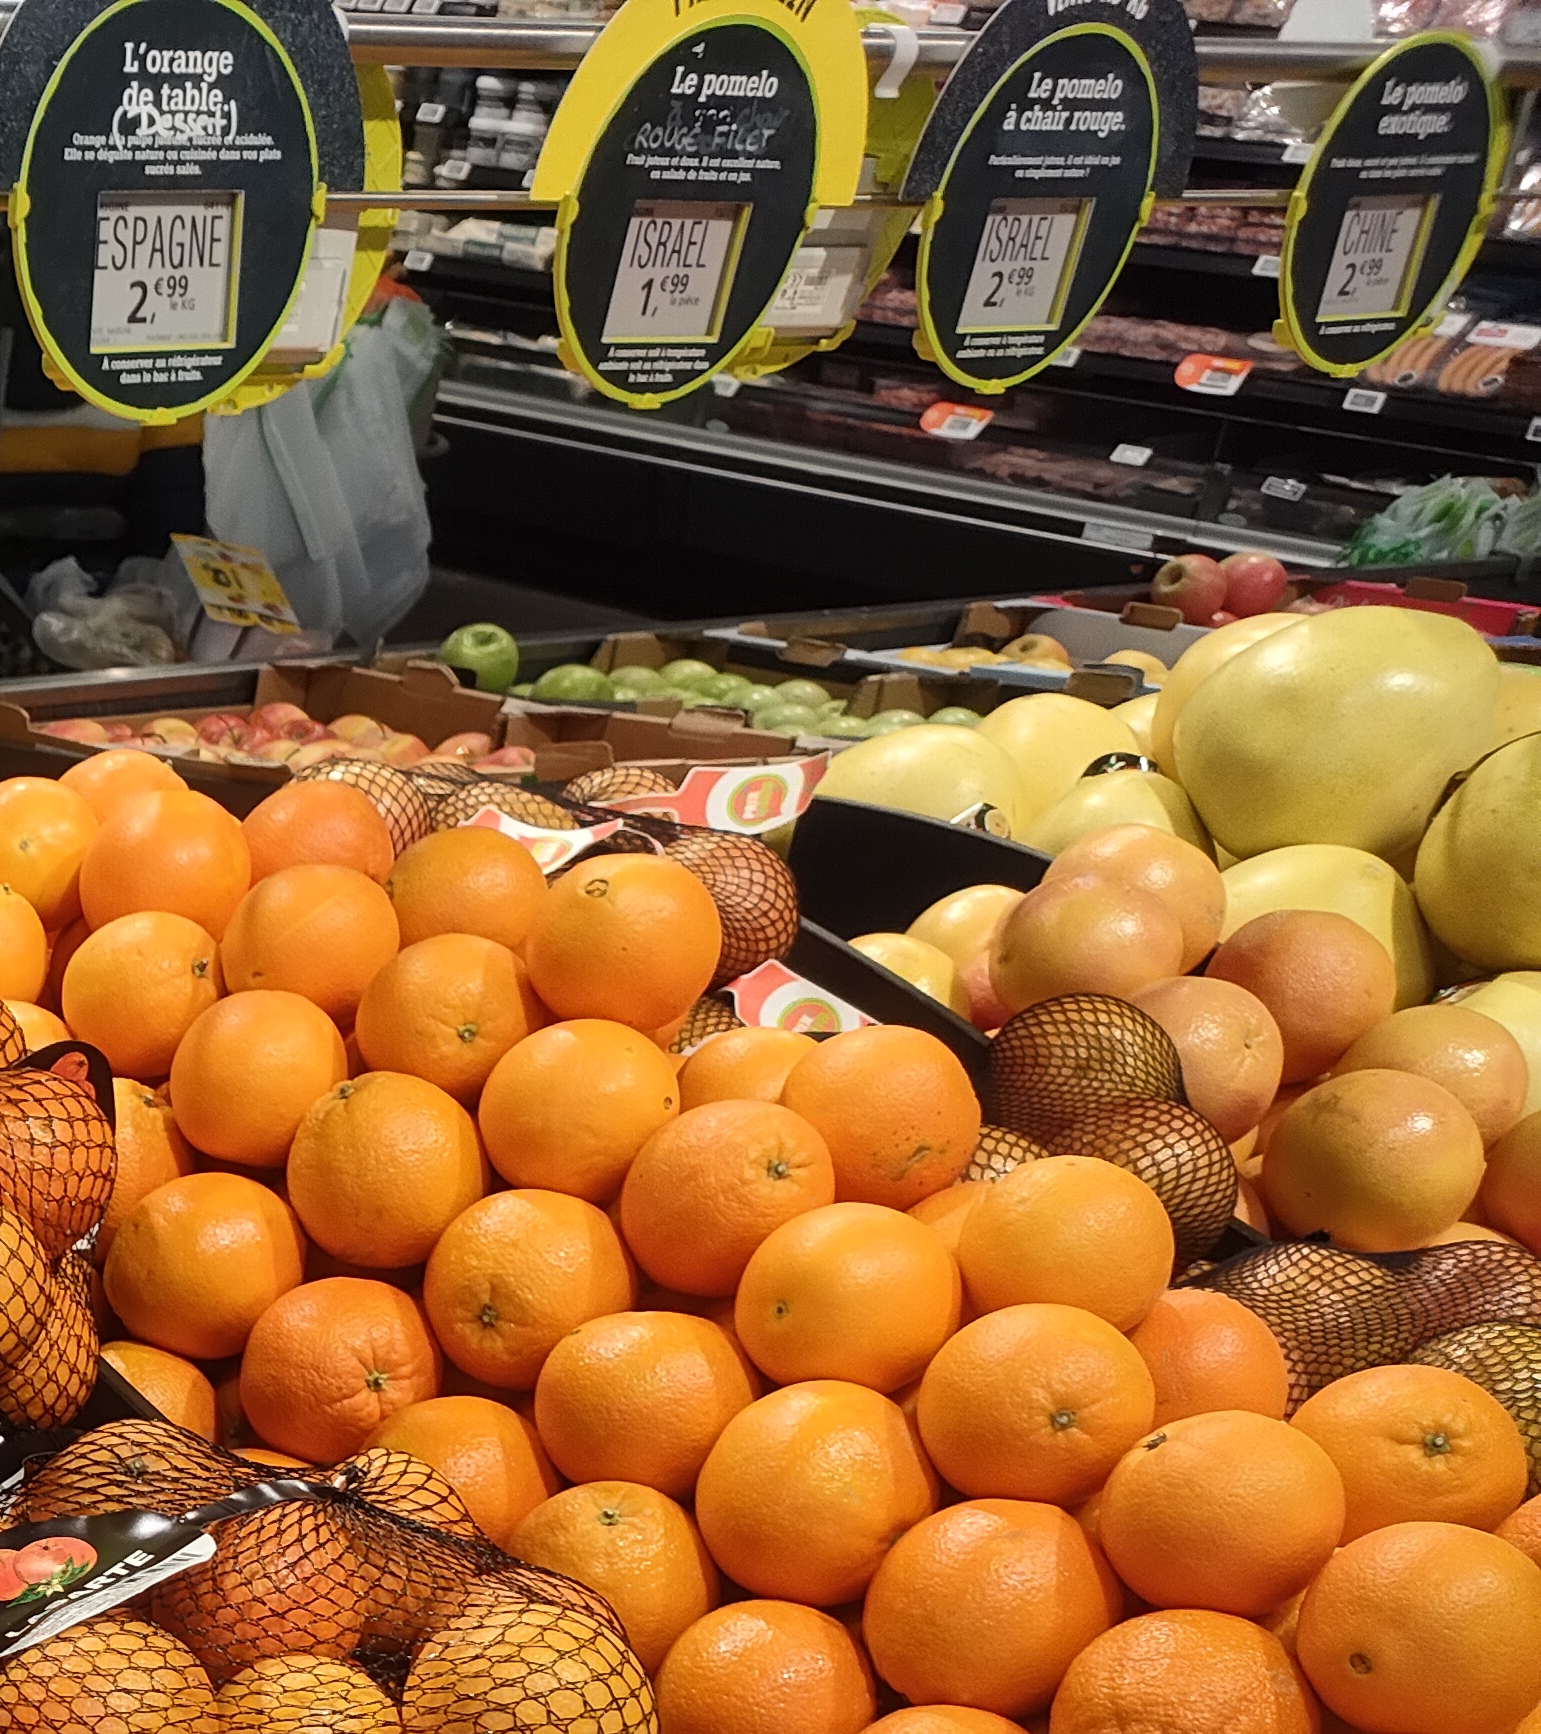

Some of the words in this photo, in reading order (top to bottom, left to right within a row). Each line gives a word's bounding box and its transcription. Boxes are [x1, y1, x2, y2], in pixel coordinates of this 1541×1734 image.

[123, 42, 234, 82] L'orange
[122, 81, 154, 111] de
[161, 81, 230, 112] table.
[670, 65, 698, 94] Le
[698, 70, 779, 103] pomelo
[1028, 71, 1052, 98] Le
[1051, 73, 1123, 105] pomelo
[1380, 76, 1406, 105] Le
[1402, 74, 1469, 110] pomelo
[1002, 103, 1017, 130] à
[1020, 104, 1070, 130] chair
[1069, 110, 1126, 138] rouge.
[95, 214, 223, 271] ESPAGNE
[629, 219, 709, 269] ISRAEL
[982, 216, 1055, 263] ISRAEL
[1342, 211, 1404, 256] CHINE
